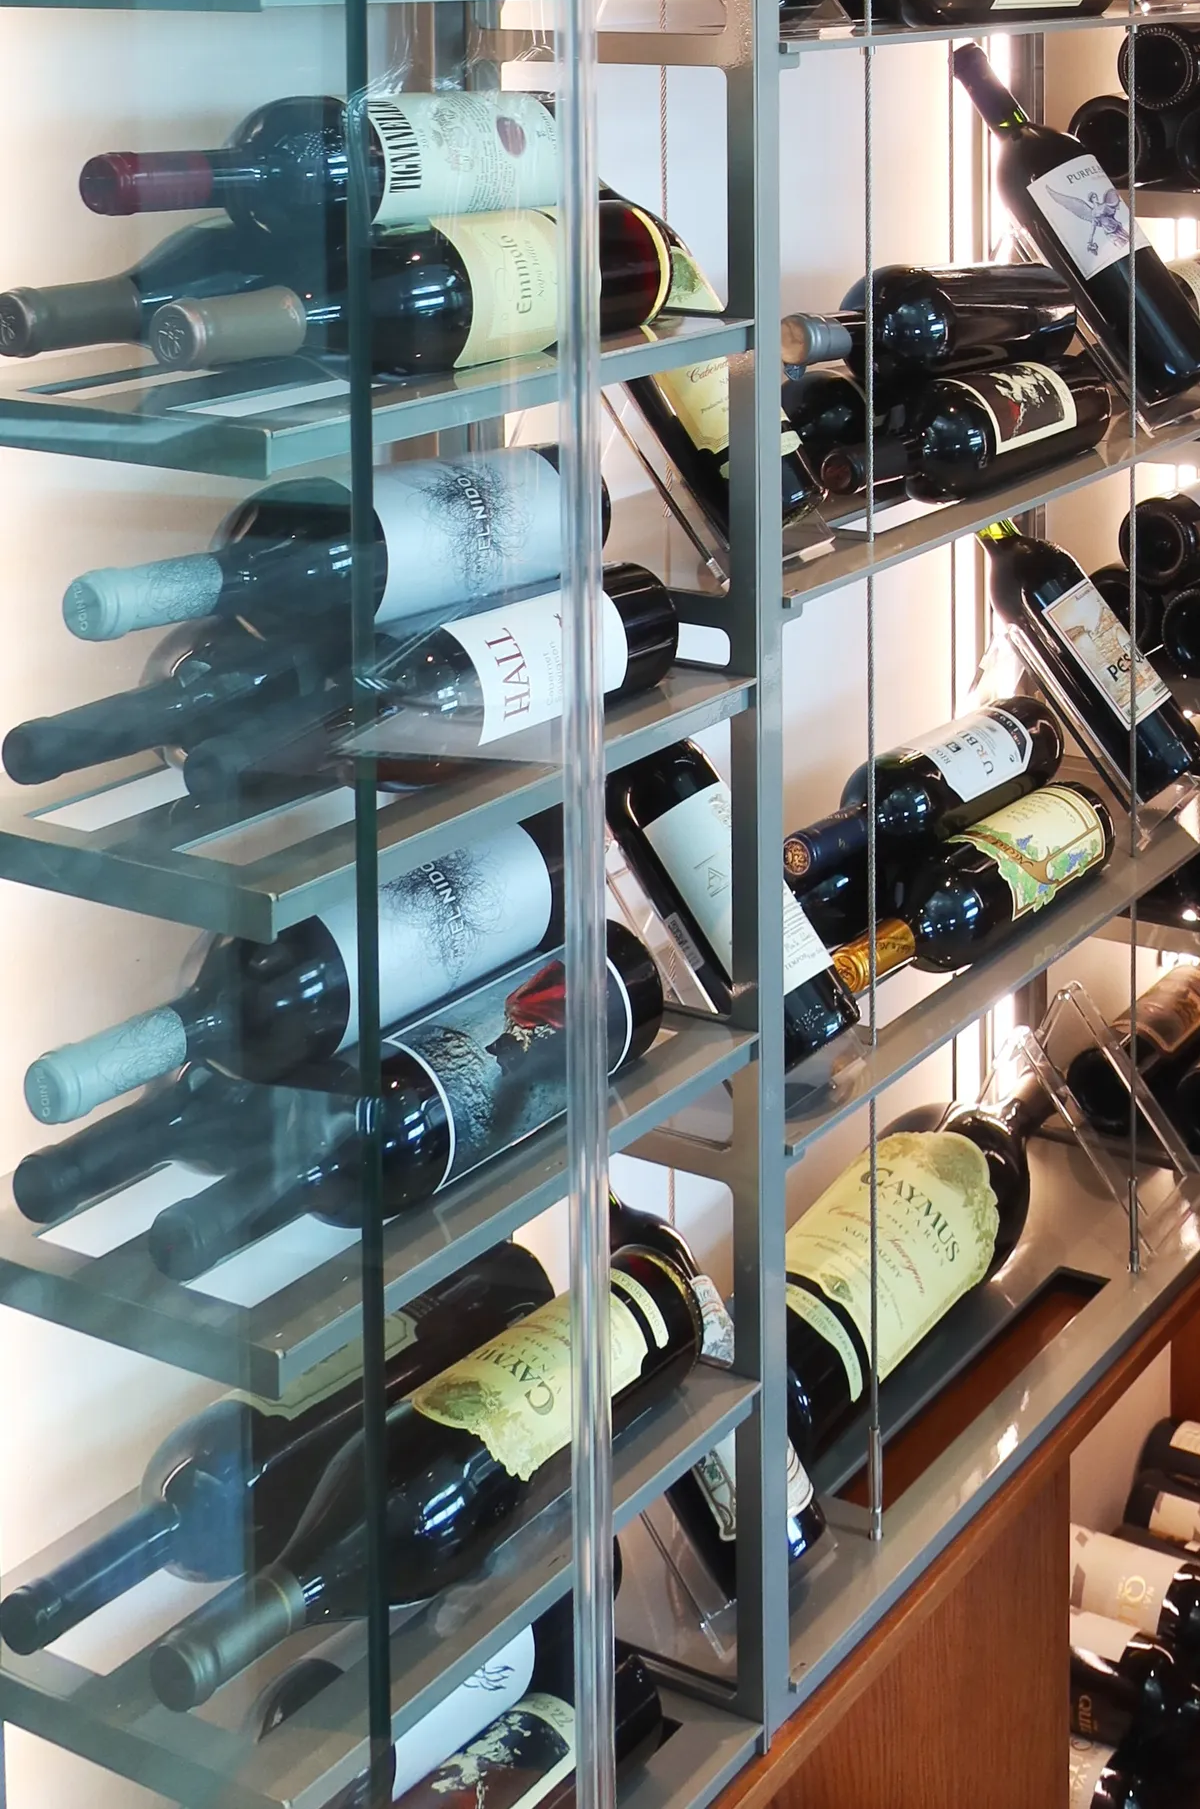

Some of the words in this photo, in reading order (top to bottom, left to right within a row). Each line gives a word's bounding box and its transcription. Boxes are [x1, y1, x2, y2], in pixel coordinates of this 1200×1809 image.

[368, 100, 423, 194] TIGNANELLO
[500, 233, 533, 315] Emmolo
[457, 475, 491, 520] NIDO
[477, 522, 492, 551] EL
[485, 627, 532, 722] HALL
[420, 861, 457, 905] NIDO
[450, 903, 464, 936] EL
[860, 1167, 960, 1262] CAYMUS
